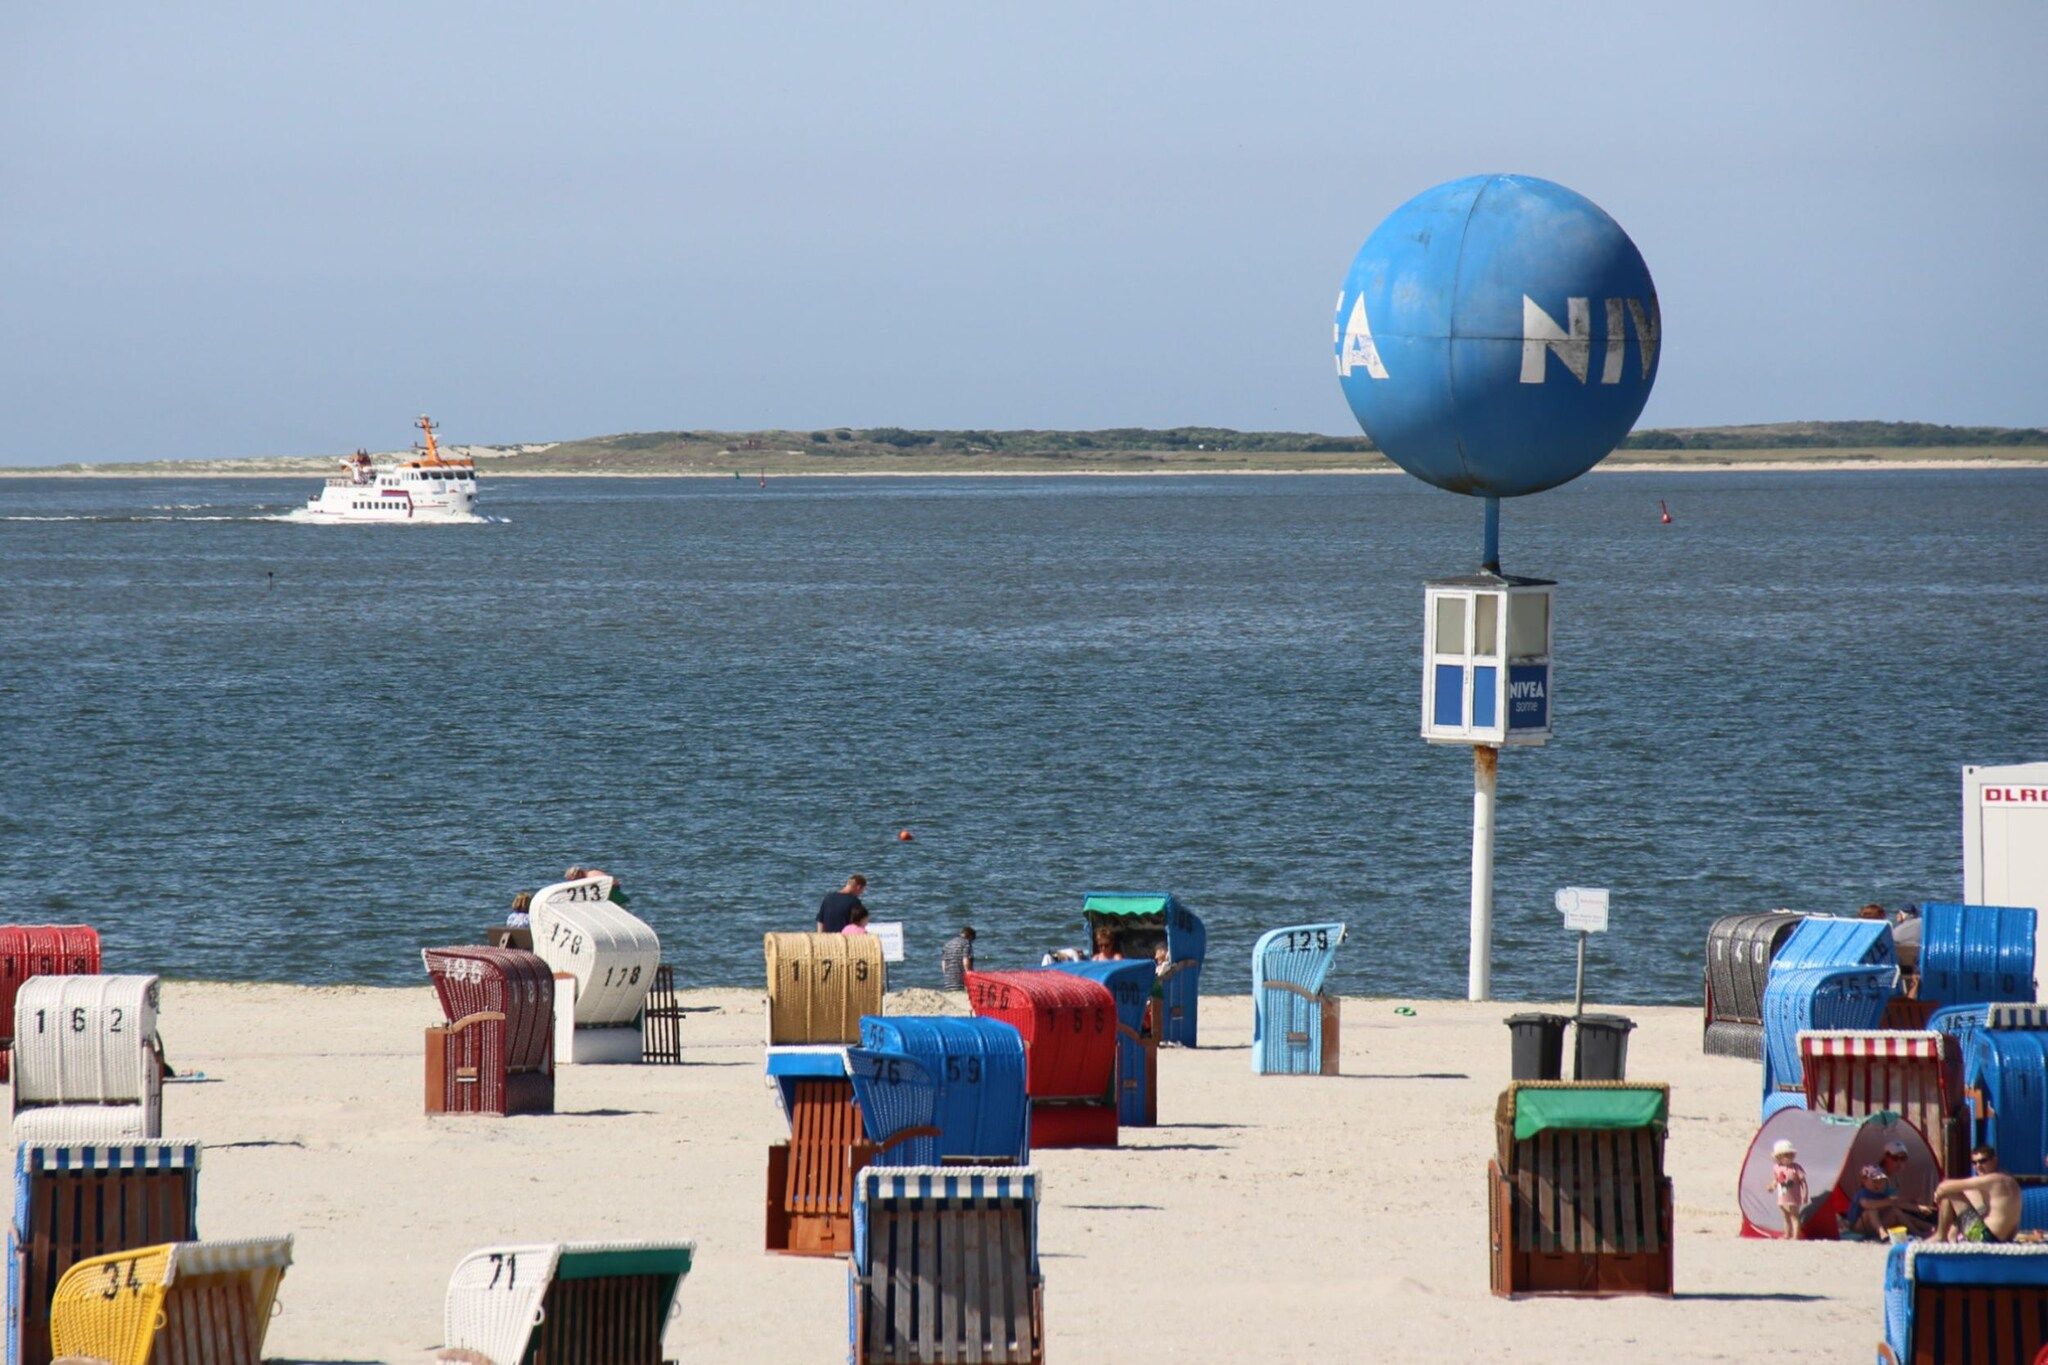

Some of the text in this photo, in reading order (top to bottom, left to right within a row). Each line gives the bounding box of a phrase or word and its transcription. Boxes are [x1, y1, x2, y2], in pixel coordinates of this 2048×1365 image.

[1334, 290, 1390, 379] A
[1509, 681, 1545, 699] NIVEA
[566, 883, 602, 902] 213
[1286, 928, 1329, 953] 129
[1716, 938, 1764, 964] 140
[604, 965, 642, 988] 178
[792, 959, 869, 981] 179
[1940, 972, 2015, 994] 110
[36, 1006, 123, 1034] 162
[872, 1056, 902, 1086] 76
[947, 1055, 981, 1084] 59
[102, 1256, 143, 1300] 34
[488, 1252, 516, 1291] 71
